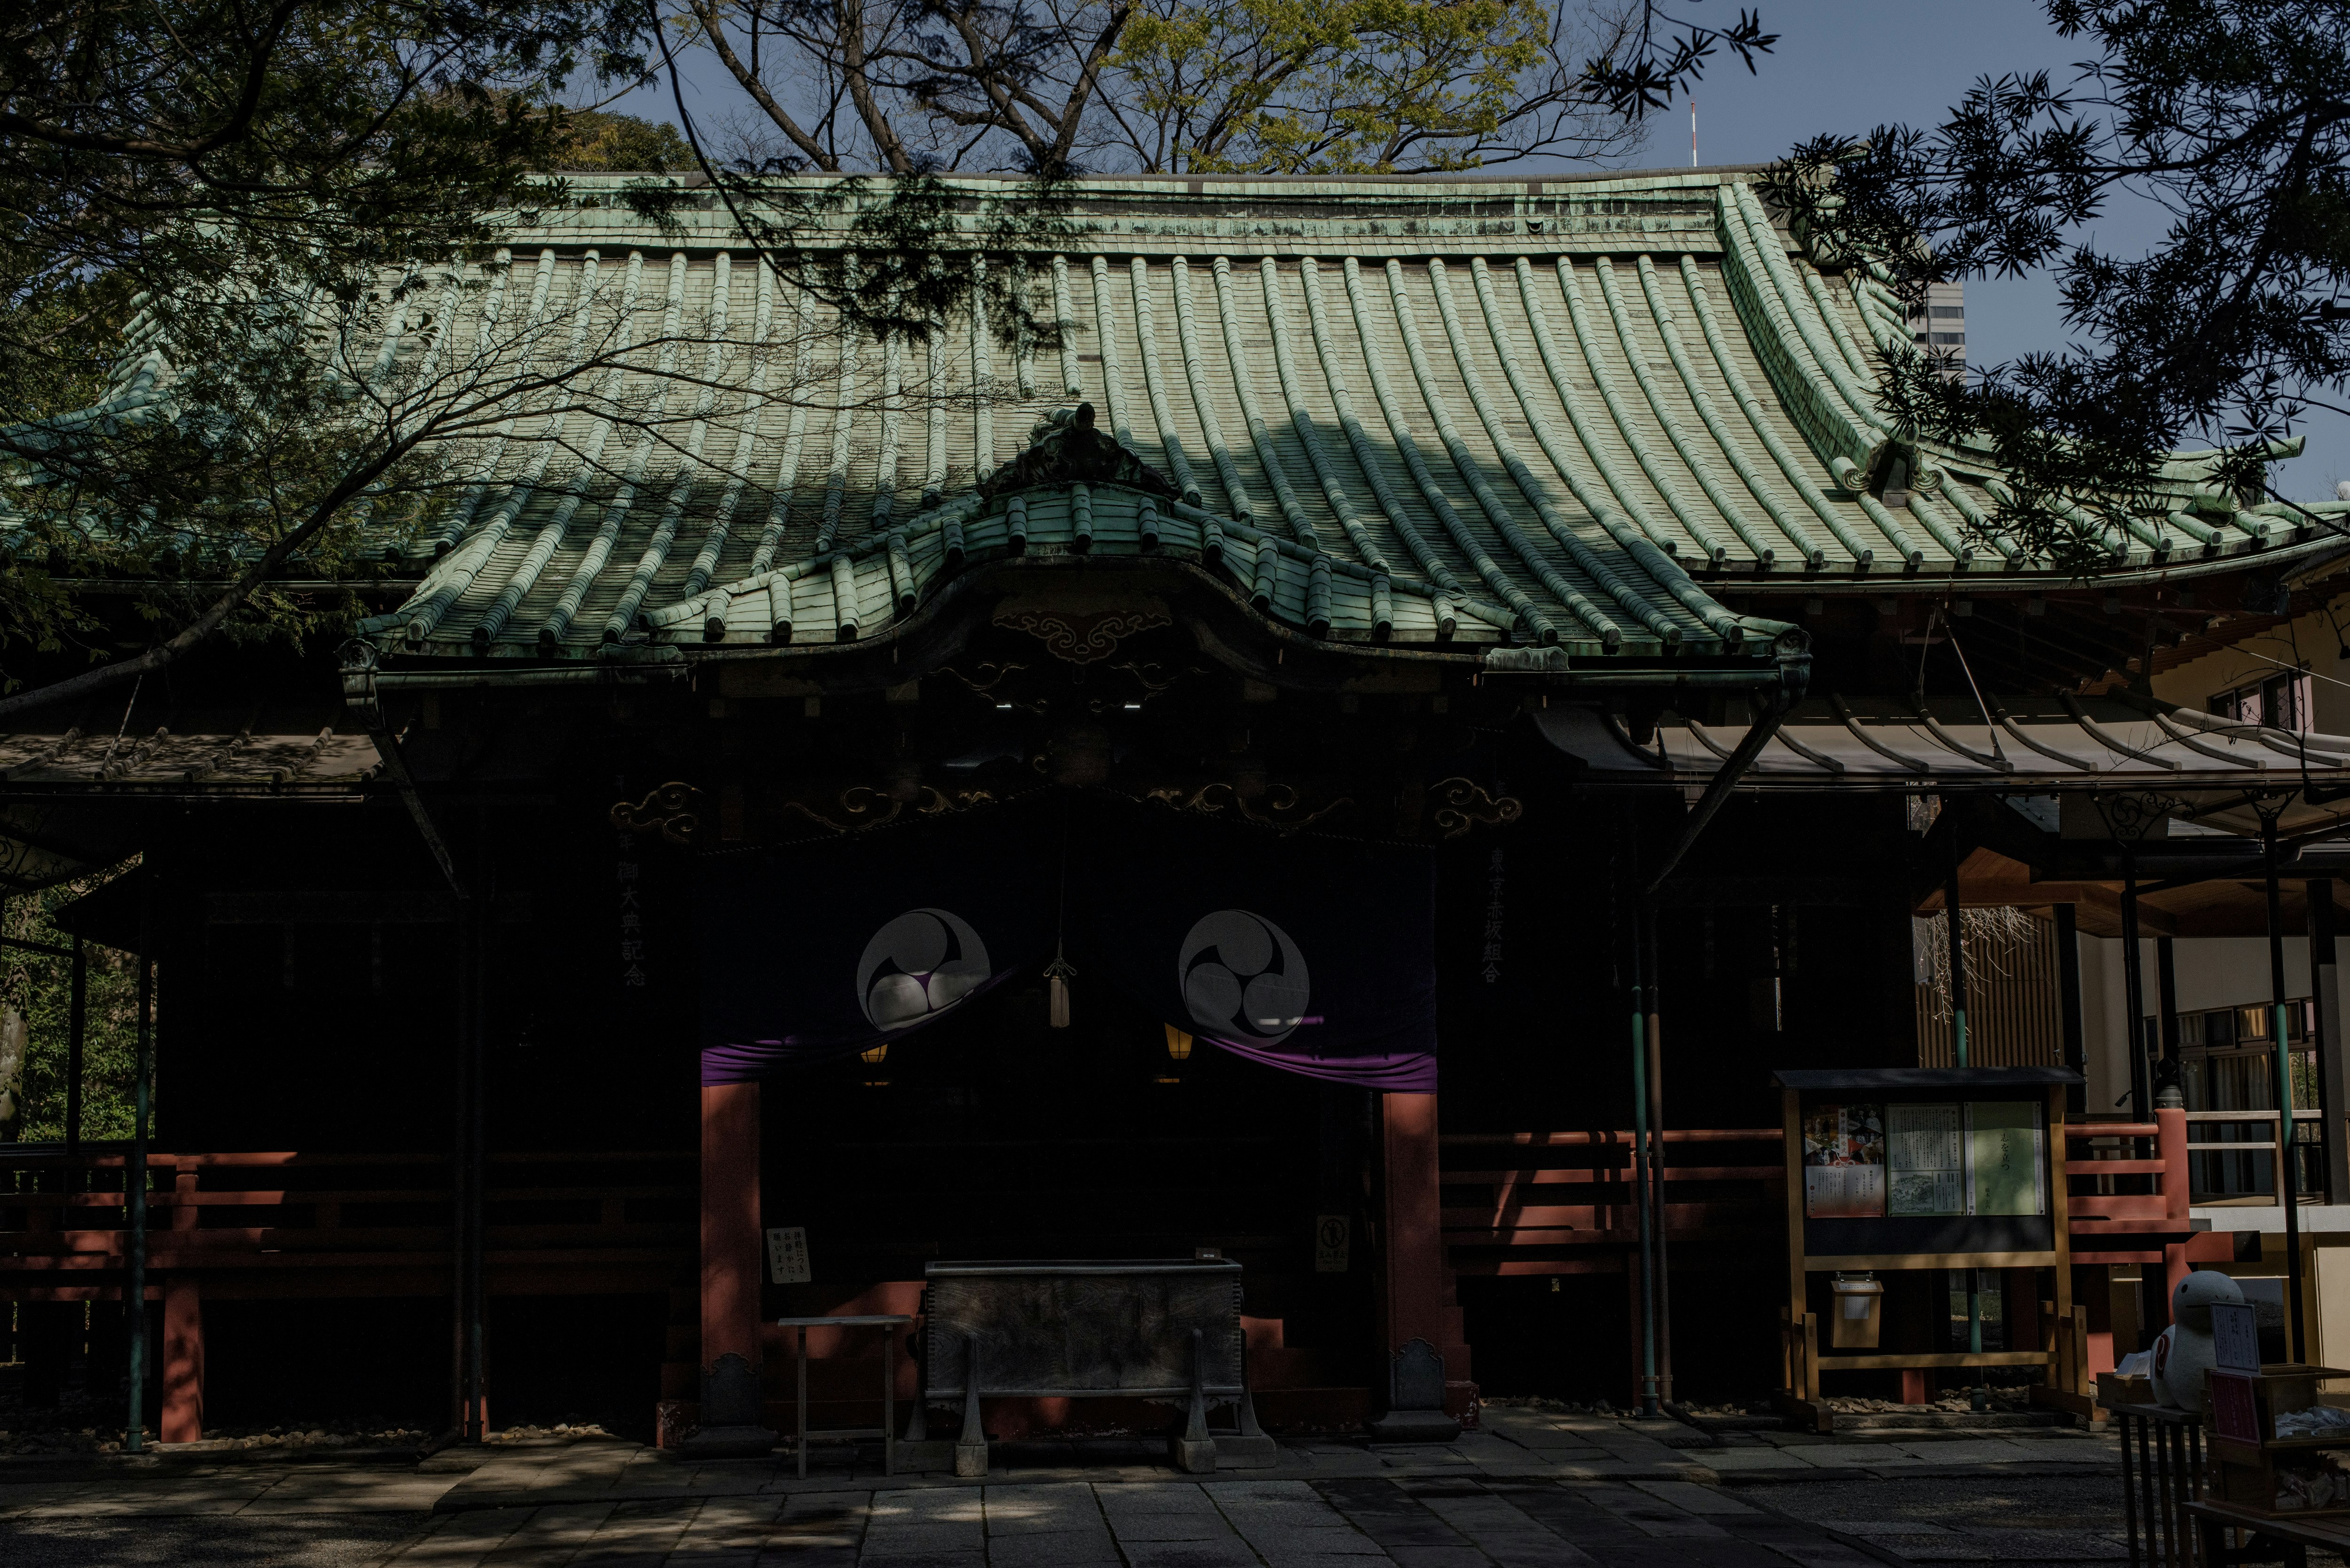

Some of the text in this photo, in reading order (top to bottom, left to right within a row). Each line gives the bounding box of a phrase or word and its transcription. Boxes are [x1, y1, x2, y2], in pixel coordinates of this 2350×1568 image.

[2000, 1133, 2010, 1170] 志を立つ
[773, 1233, 784, 1274] 願います
[784, 1232, 795, 1273] お静かに
